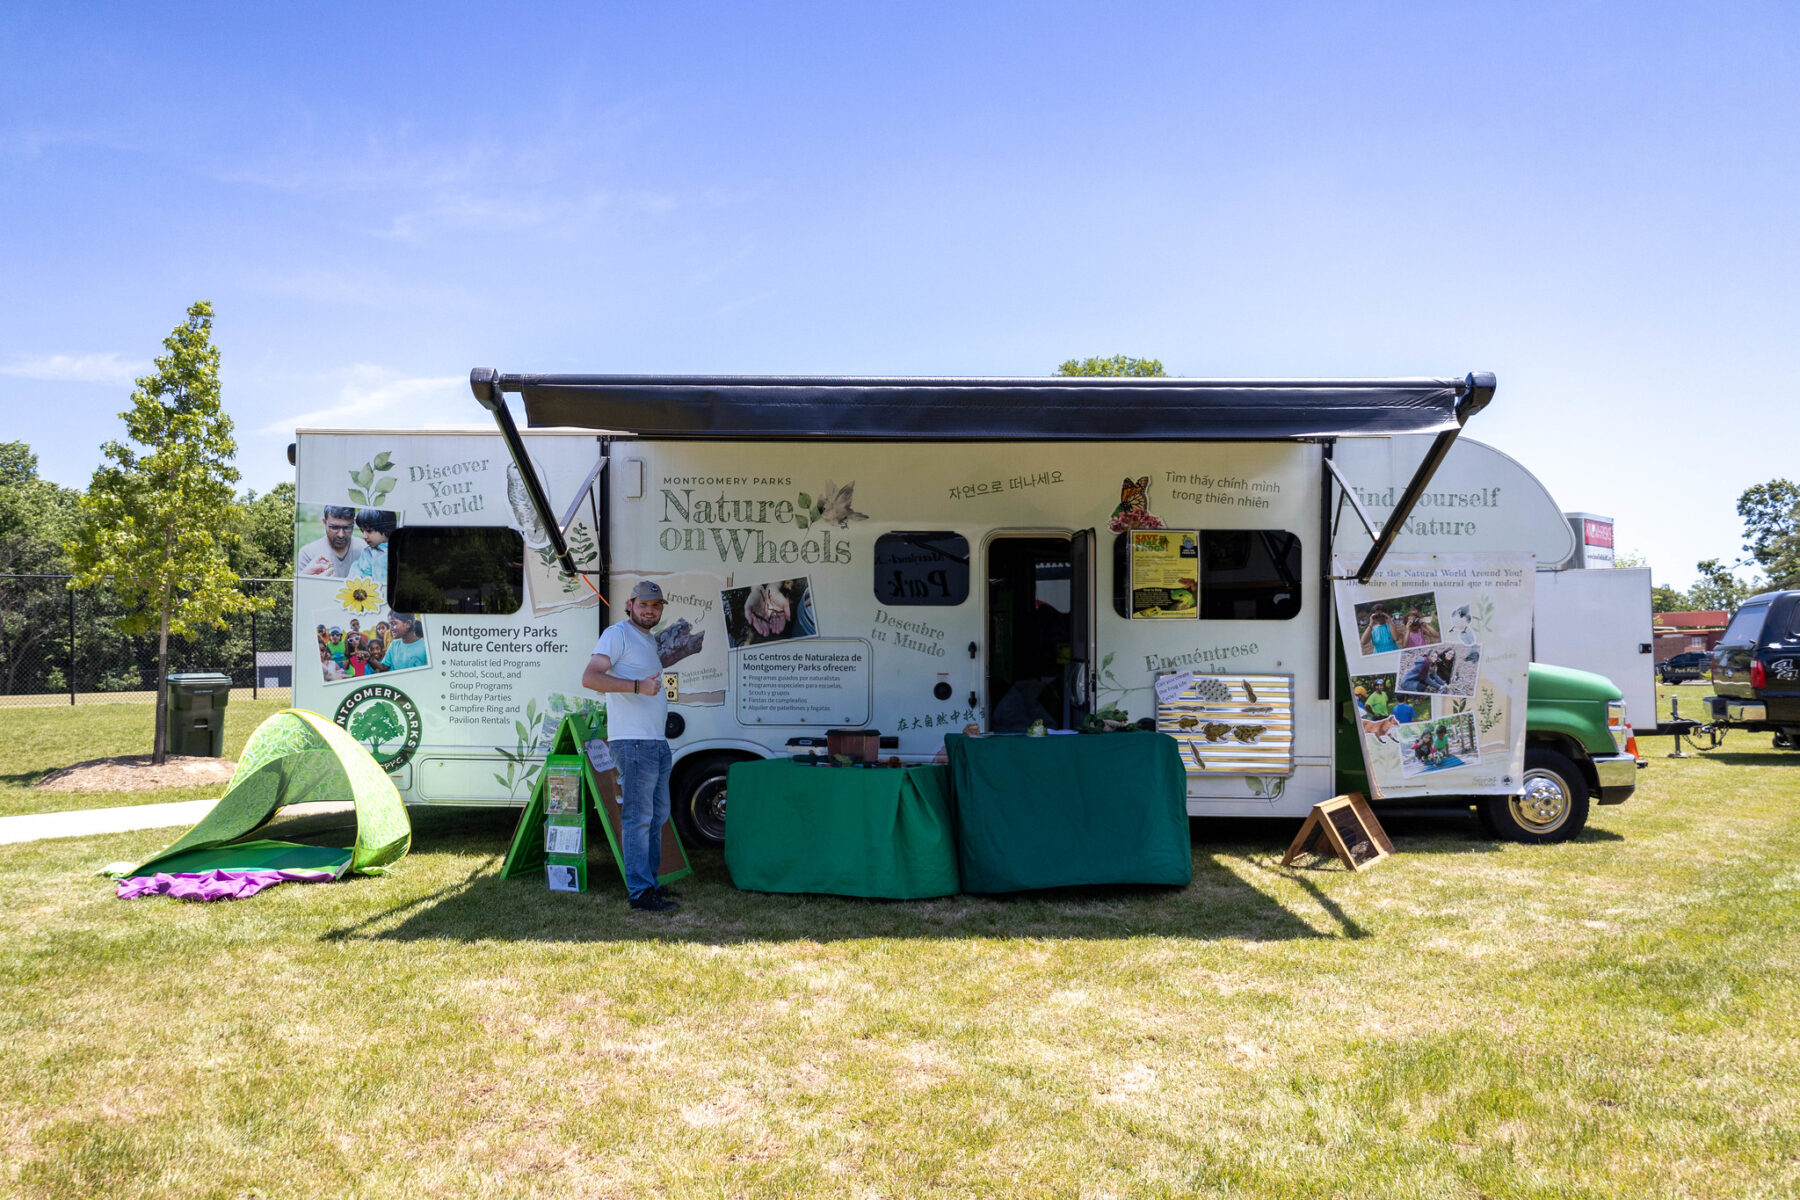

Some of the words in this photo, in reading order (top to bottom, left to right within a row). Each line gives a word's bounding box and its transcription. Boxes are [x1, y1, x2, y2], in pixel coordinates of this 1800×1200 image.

[408, 459, 489, 482] Discover
[427, 481, 473, 499] Your
[663, 477, 748, 485] MONTGOMERY
[753, 477, 792, 486] PARKS
[949, 480, 1004, 500] 자연으로
[1009, 471, 1064, 490] 떠나세요
[1165, 471, 1186, 483] Tìm
[1190, 474, 1214, 489] thấy
[1217, 477, 1248, 491] chính
[1251, 480, 1281, 494] mình
[422, 494, 484, 519] World!
[658, 489, 795, 524] Nature
[1172, 489, 1203, 505] trong
[1205, 492, 1234, 505] thiên
[1237, 496, 1269, 509] nhiên
[1400, 487, 1501, 508] ourself
[1399, 515, 1477, 536] Nature
[659, 527, 707, 551] on
[707, 527, 852, 565] Wheels
[1135, 534, 1159, 543] SAVE
[1387, 569, 1401, 577] the
[1404, 569, 1438, 577] Natural
[1441, 569, 1467, 577] World
[1471, 569, 1501, 577] Around
[667, 592, 713, 611] treefrog
[442, 625, 520, 639] Montgomery
[523, 626, 558, 638] Parks
[874, 609, 945, 640] Descubre
[442, 641, 483, 652] Nature
[486, 641, 532, 653] Centers
[535, 641, 568, 653] offer:
[871, 628, 887, 642] tu
[892, 631, 946, 658] Mundo
[450, 659, 488, 667] Naturalist
[489, 659, 502, 667] led
[503, 659, 541, 669] Programs
[743, 653, 758, 661] Los
[759, 653, 791, 661] Centros
[793, 653, 803, 661] de
[805, 653, 850, 661] Naturaleza
[851, 654, 862, 662] de
[1144, 642, 1259, 673] Encuéntrese
[450, 670, 479, 679] School,
[480, 670, 505, 679] Scout,
[506, 671, 522, 679] and
[743, 663, 795, 673] Montgomery
[798, 663, 821, 671] Parks
[823, 663, 857, 672] ofrecen:
[449, 681, 474, 691] Group
[475, 682, 513, 691] Programs
[449, 693, 483, 703] Birthday
[484, 693, 512, 701] Parties
[336, 687, 402, 725] NTGOMERY
[402, 702, 419, 749] PARKS
[449, 704, 485, 714] Campfire
[486, 704, 504, 714] Ring
[505, 705, 520, 713] and
[449, 715, 480, 724] Pavilion
[481, 716, 511, 724] Rentals
